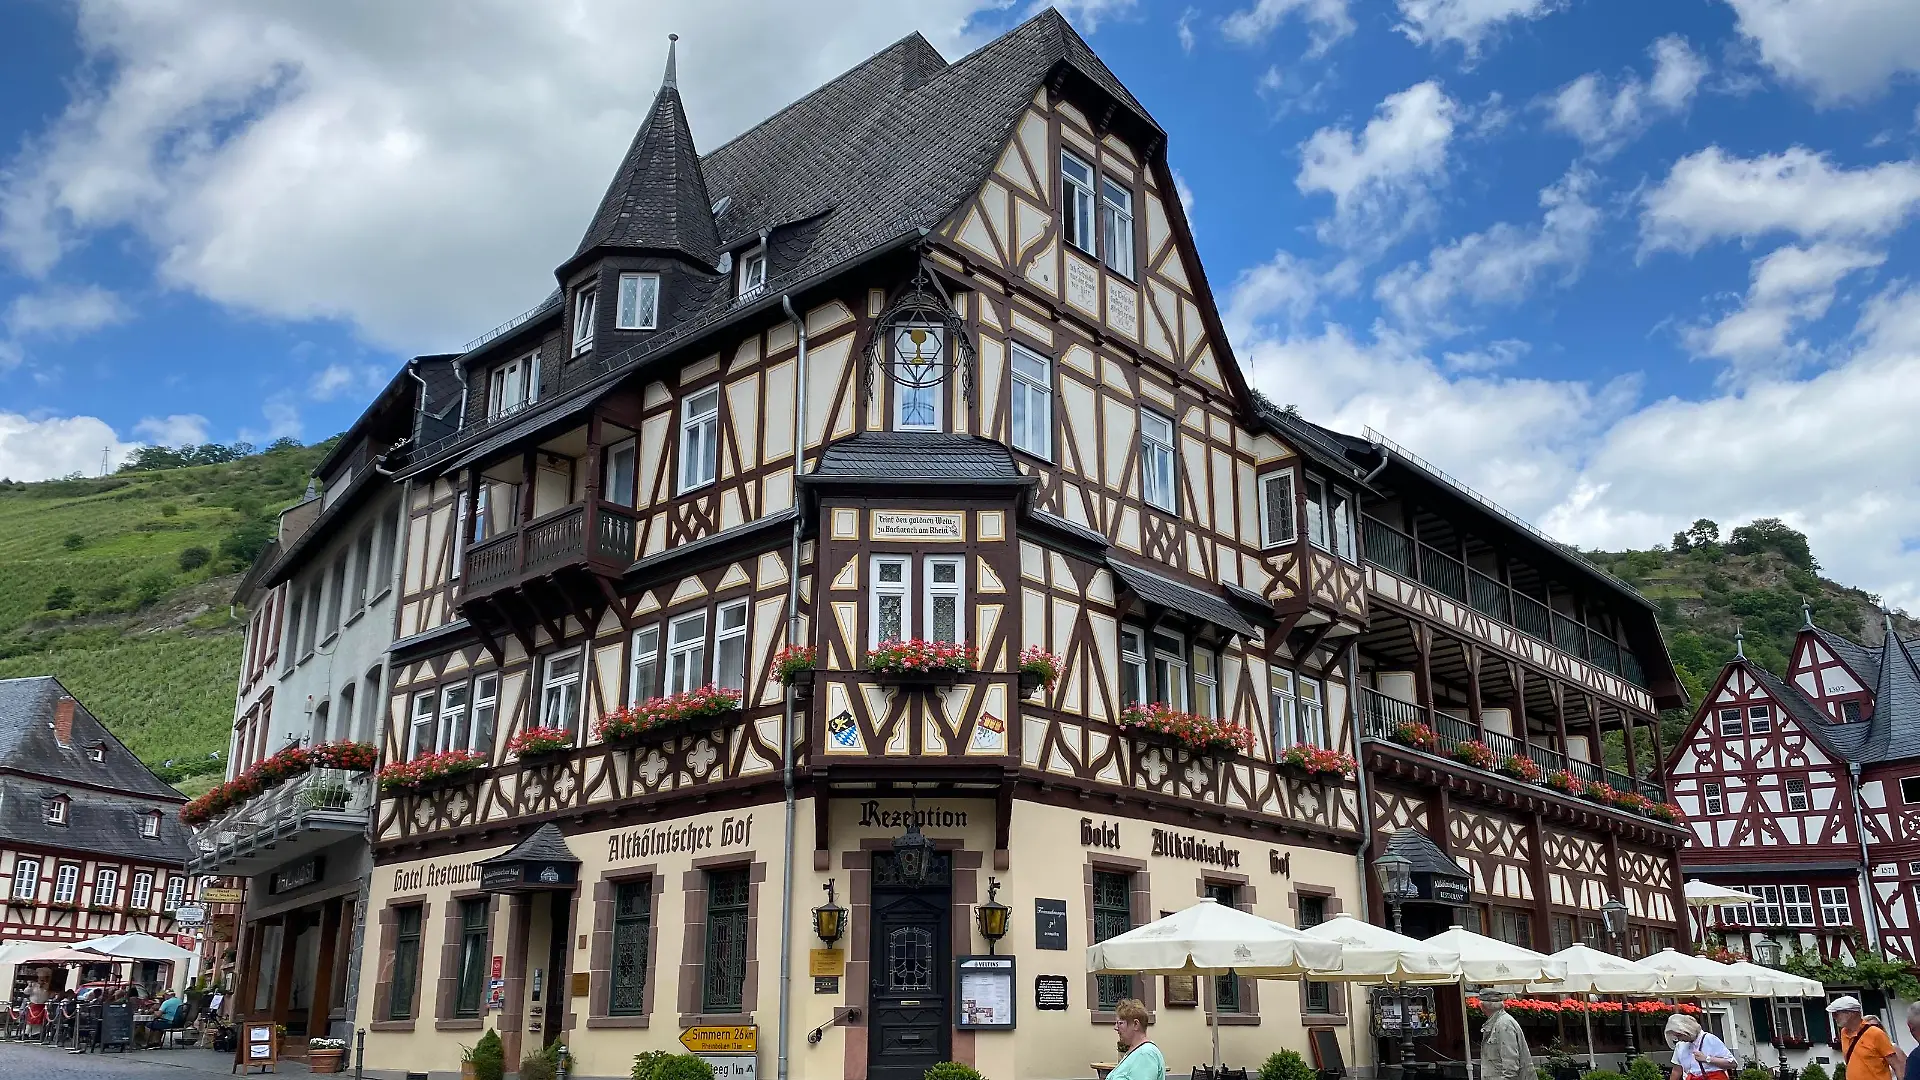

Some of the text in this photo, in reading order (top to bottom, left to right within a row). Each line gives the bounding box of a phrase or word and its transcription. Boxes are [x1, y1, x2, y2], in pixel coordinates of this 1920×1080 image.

[859, 799, 968, 828] Rezeption
[608, 813, 753, 863] Altkölnischer Hof
[1080, 816, 1121, 850] Hotel
[1151, 827, 1241, 870] Altkölnischer
[394, 862, 480, 892] Hotel Restaura
[1269, 848, 1291, 880] Hof
[692, 1028, 754, 1040] Simmern 26 km
